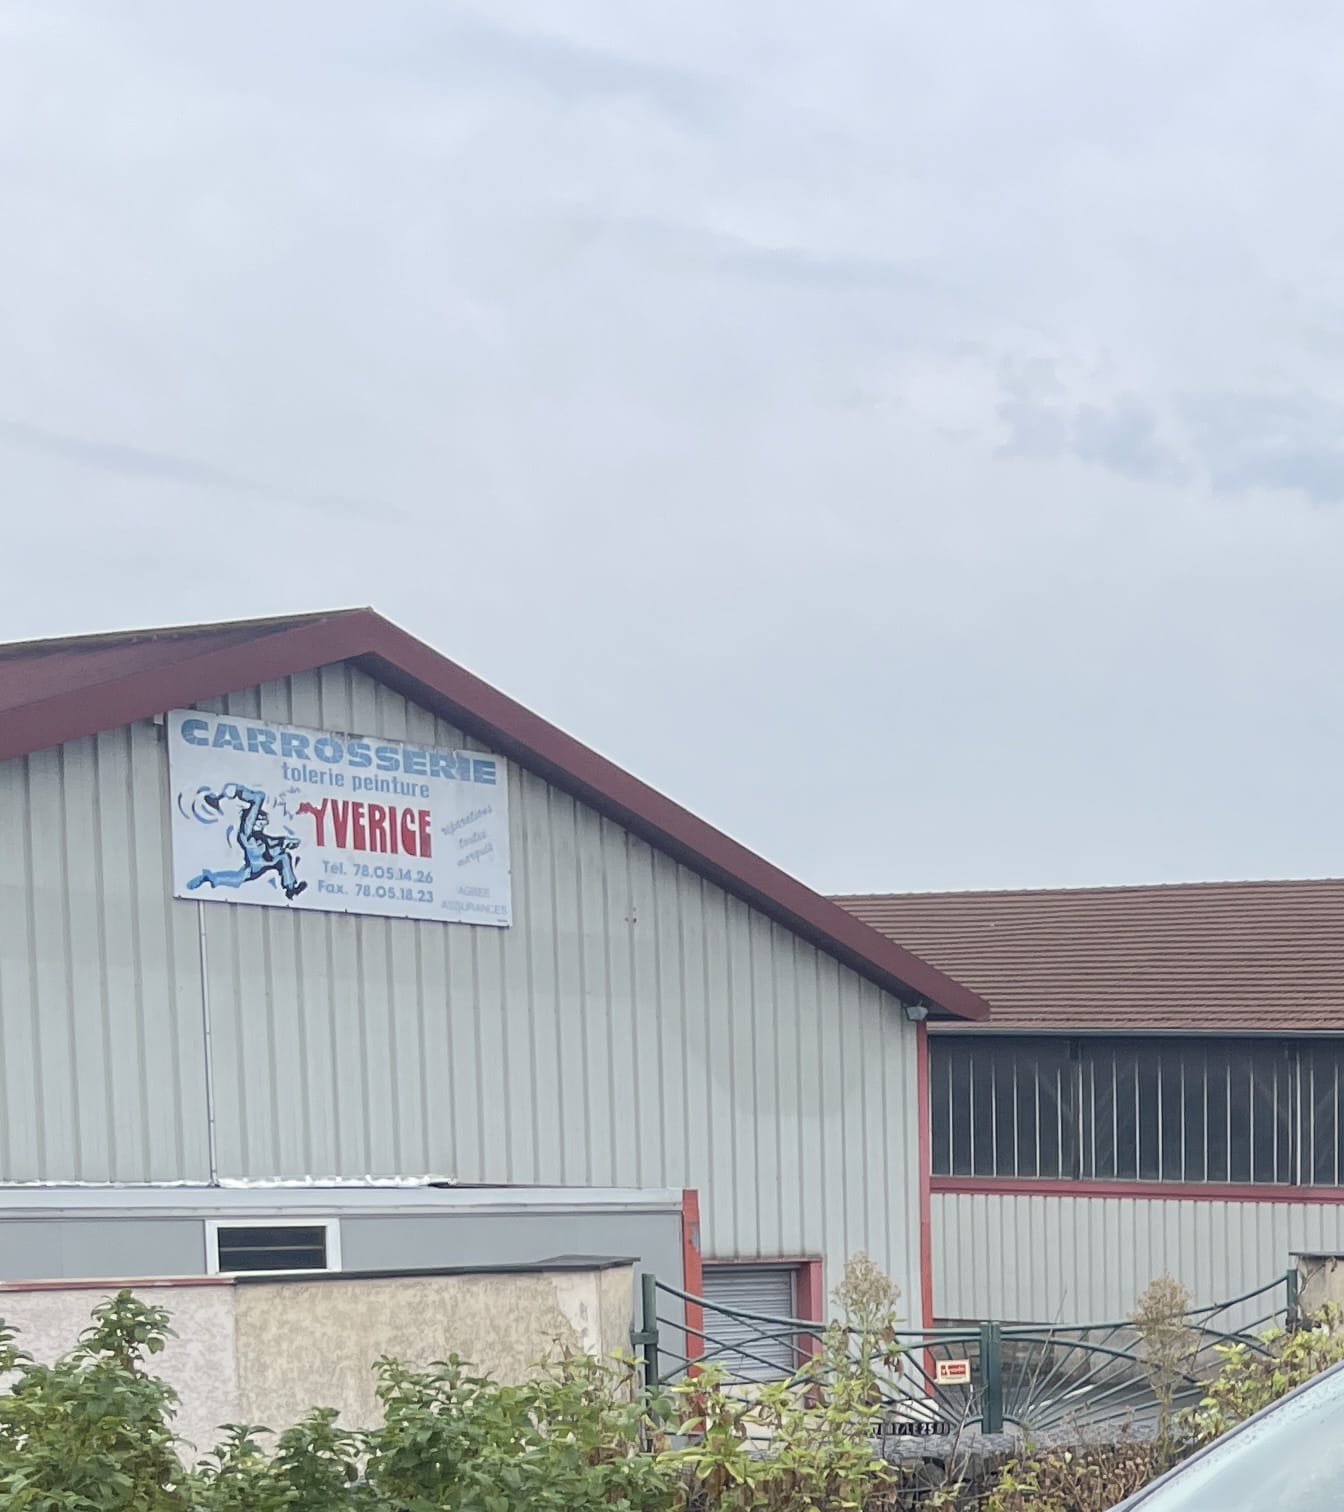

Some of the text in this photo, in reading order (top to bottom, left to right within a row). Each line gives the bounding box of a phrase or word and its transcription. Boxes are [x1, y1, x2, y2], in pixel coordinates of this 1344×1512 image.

[181, 718, 497, 786] CARROSSERIE
[282, 761, 430, 799] tolerie peinture
